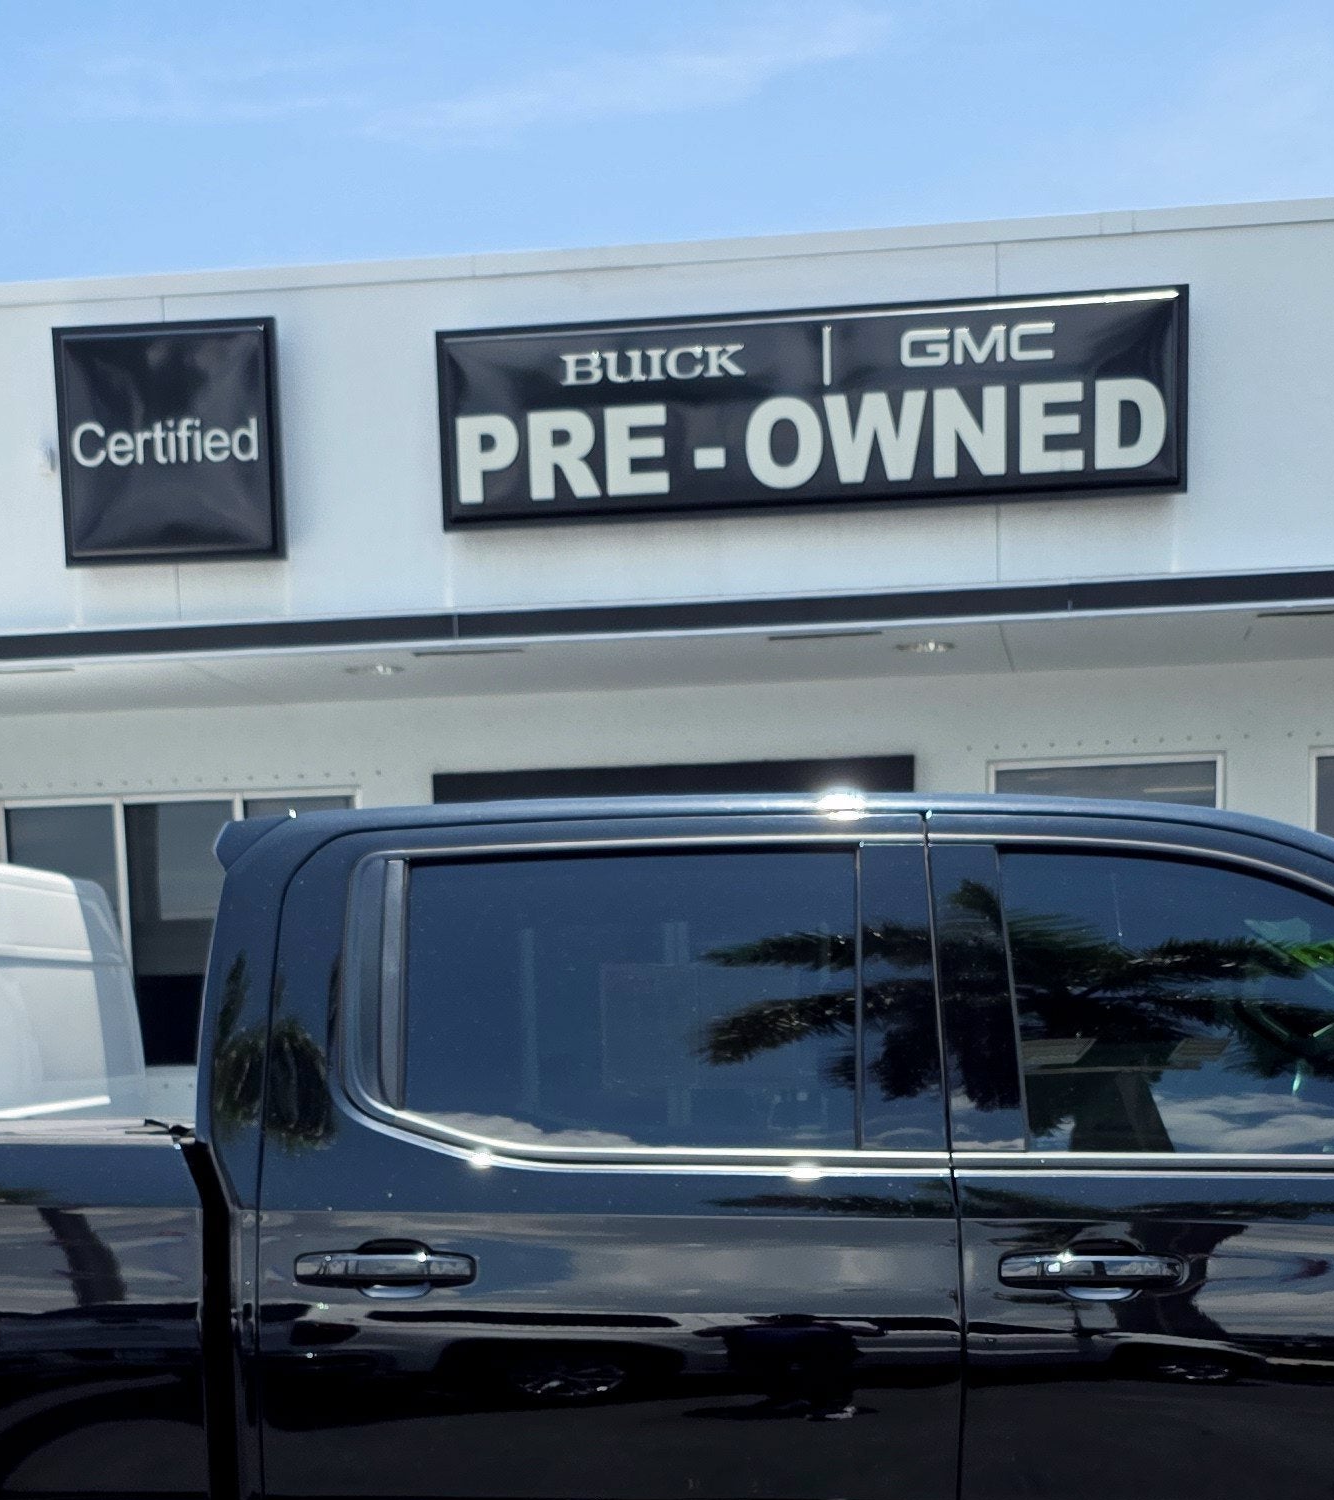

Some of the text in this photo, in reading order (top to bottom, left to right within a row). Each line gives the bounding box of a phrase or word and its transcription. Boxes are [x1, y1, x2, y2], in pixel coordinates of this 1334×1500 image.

[560, 321, 1056, 387] BUICK GMC
[71, 416, 260, 468] Certified
[455, 403, 670, 505] PRE
[745, 377, 1168, 490] OWNED
